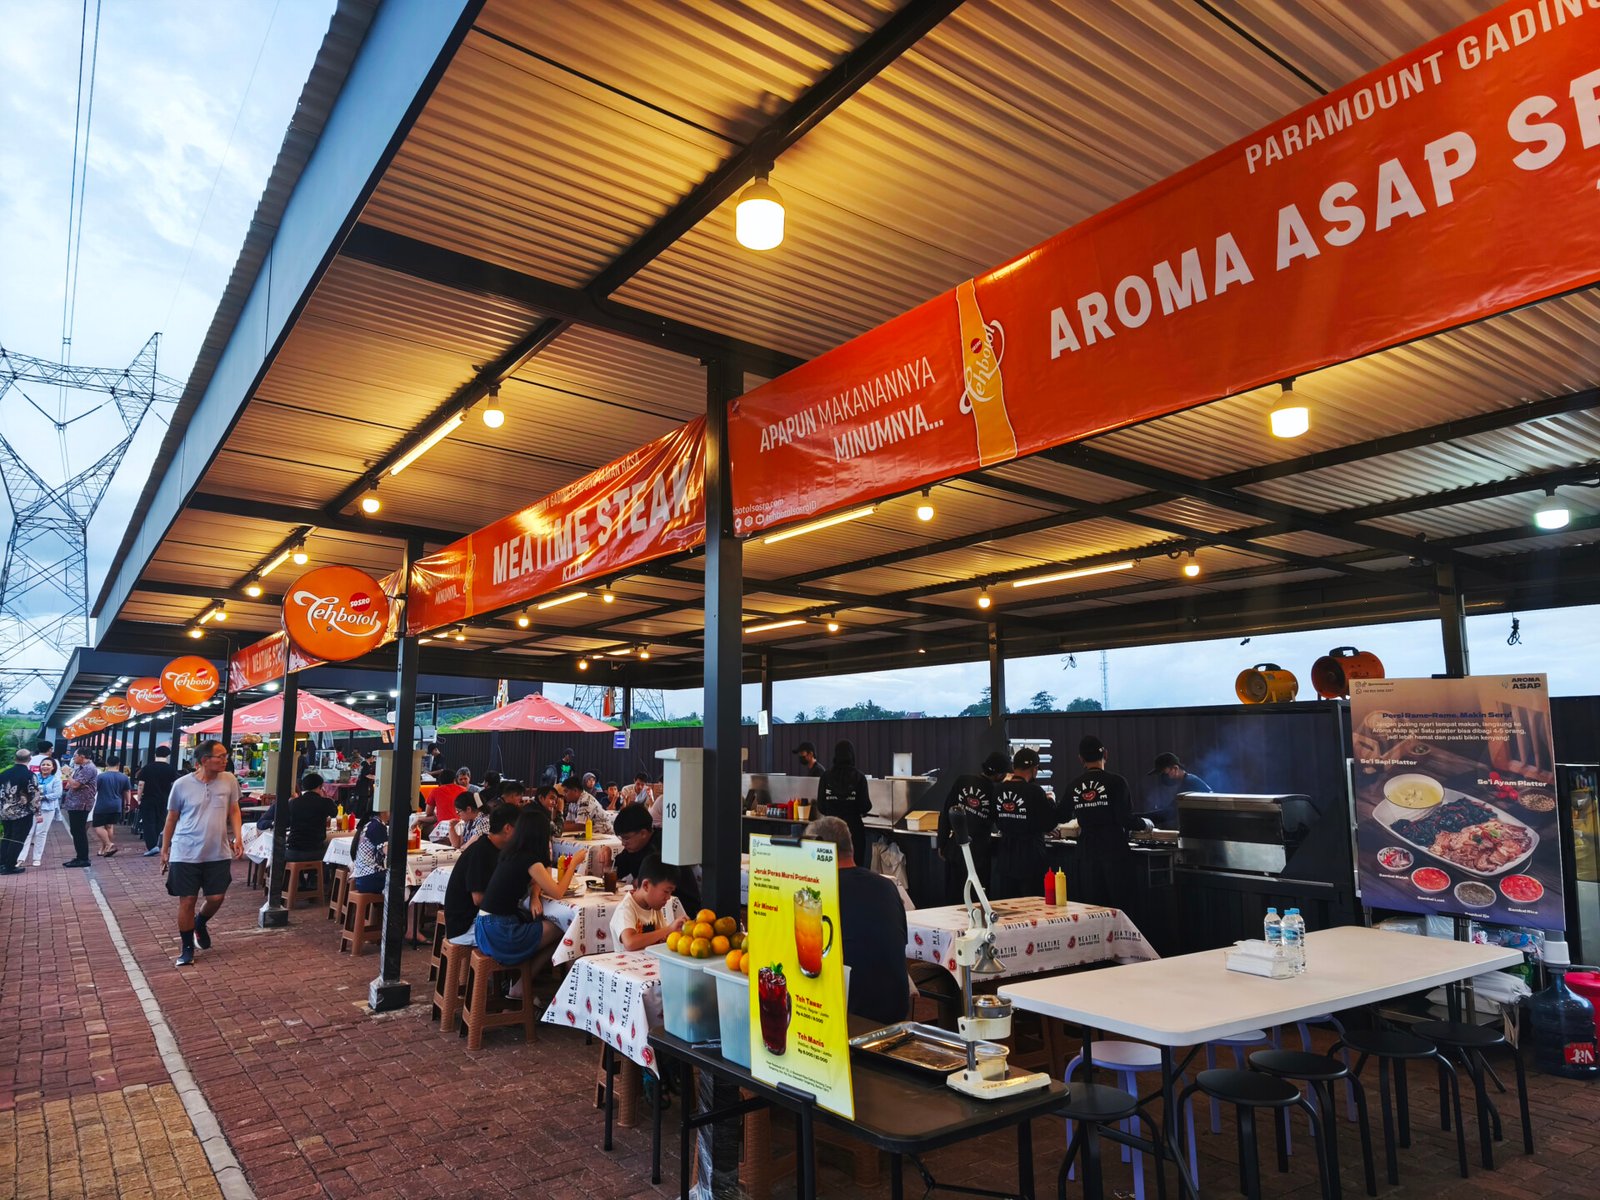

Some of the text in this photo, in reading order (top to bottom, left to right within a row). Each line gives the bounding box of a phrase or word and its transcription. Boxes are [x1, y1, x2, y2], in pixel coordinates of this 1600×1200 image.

[1244, 51, 1443, 175] PARAMOUNT
[1049, 232, 1254, 360] AROMA
[1275, 131, 1478, 272] ASAP
[959, 319, 1005, 415] Tehbotol
[759, 356, 936, 453] APAPUN MAKANANNYA
[492, 457, 691, 586] MEATIME STEAK
[293, 590, 382, 637] Tehbotol
[165, 671, 216, 693] Tehbotol
[1073, 780, 1108, 803] MEATIME
[1494, 779, 1517, 787] Ayam
[666, 803, 677, 818] 18
[996, 791, 1027, 813] MEATIME
[816, 847, 833, 855] AROMA
[816, 855, 833, 863] ASAP
[761, 902, 779, 912] Mineral
[1036, 939, 1060, 949] MEATIME
[795, 994, 805, 1004] Teh
[806, 997, 823, 1009] Tawar
[797, 1031, 808, 1040] Teh
[808, 1035, 825, 1048] Manis
